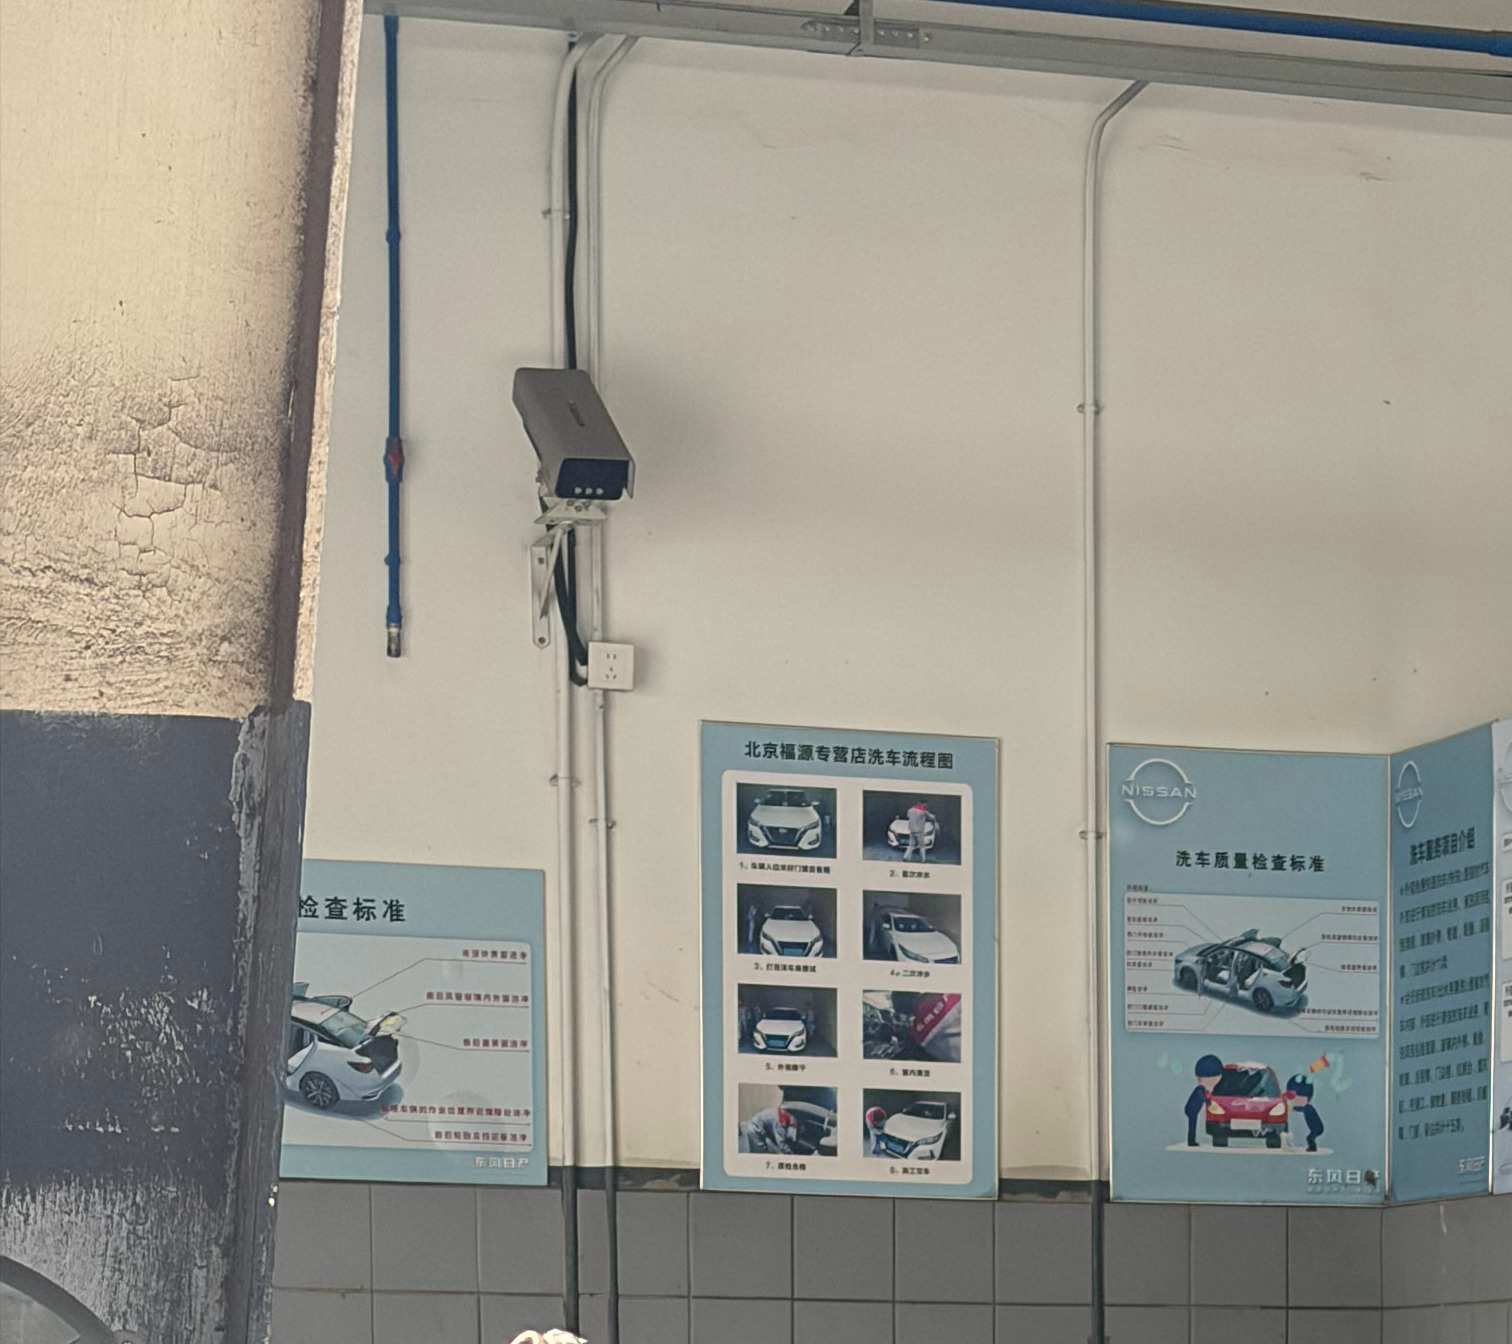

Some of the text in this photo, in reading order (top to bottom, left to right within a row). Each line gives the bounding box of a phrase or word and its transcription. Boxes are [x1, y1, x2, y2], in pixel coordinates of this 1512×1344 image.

[744, 740, 954, 770] 北京福源专营店洗车流程图
[1121, 784, 1197, 799] NISSAN
[1175, 850, 1325, 873] 洗车质量检查标准
[298, 895, 407, 923] 检查标准
[1307, 1168, 1380, 1184] 东风日
